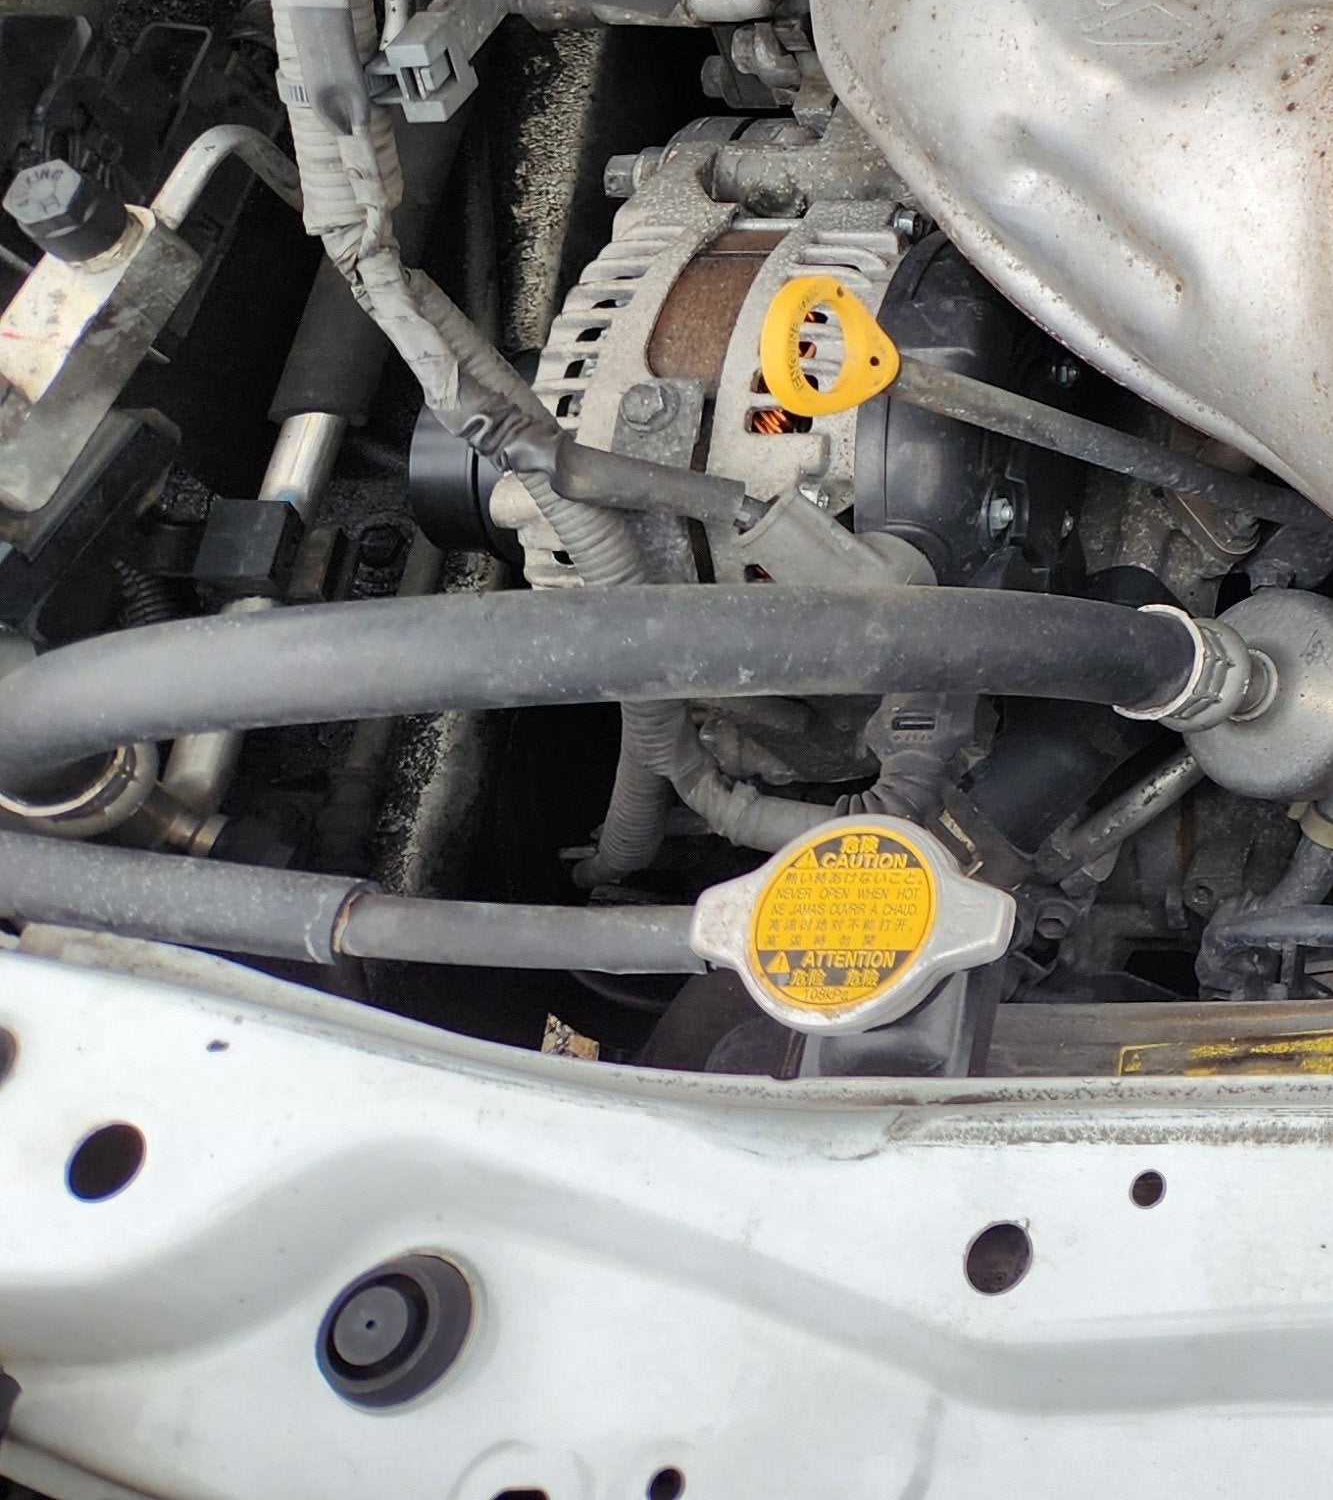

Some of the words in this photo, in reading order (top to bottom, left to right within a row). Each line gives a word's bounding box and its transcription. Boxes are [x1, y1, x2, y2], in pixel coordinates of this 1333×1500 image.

[820, 851, 908, 870] CAUTION
[776, 887, 812, 900] NEVER
[819, 887, 850, 900] OPEN
[857, 887, 889, 900] WHEN
[771, 902, 785, 916] NE
[789, 902, 825, 916] JAMAIS
[800, 950, 896, 969] ATTENTION
